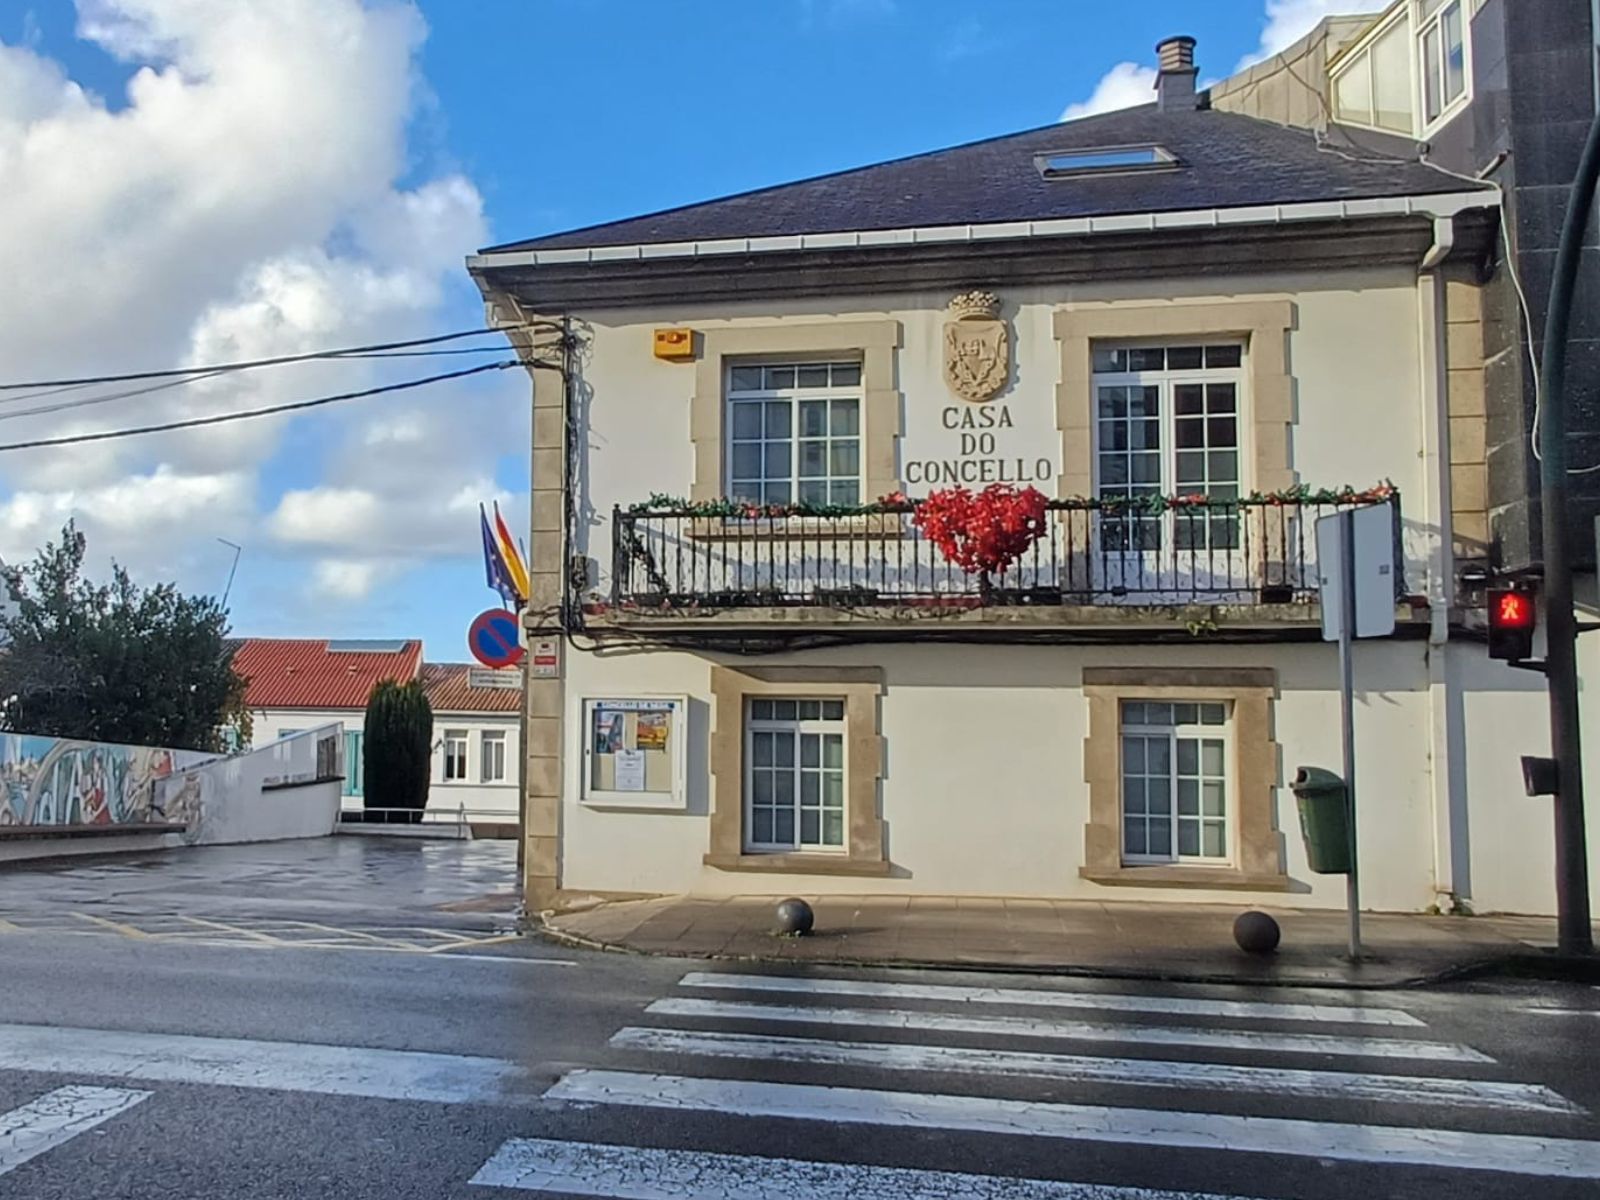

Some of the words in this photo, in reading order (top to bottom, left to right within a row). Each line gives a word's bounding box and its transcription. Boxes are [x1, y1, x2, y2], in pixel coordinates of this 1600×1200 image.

[942, 406, 1013, 429] CASA
[961, 432, 995, 455] DO
[906, 458, 1051, 483] CONCELLO
